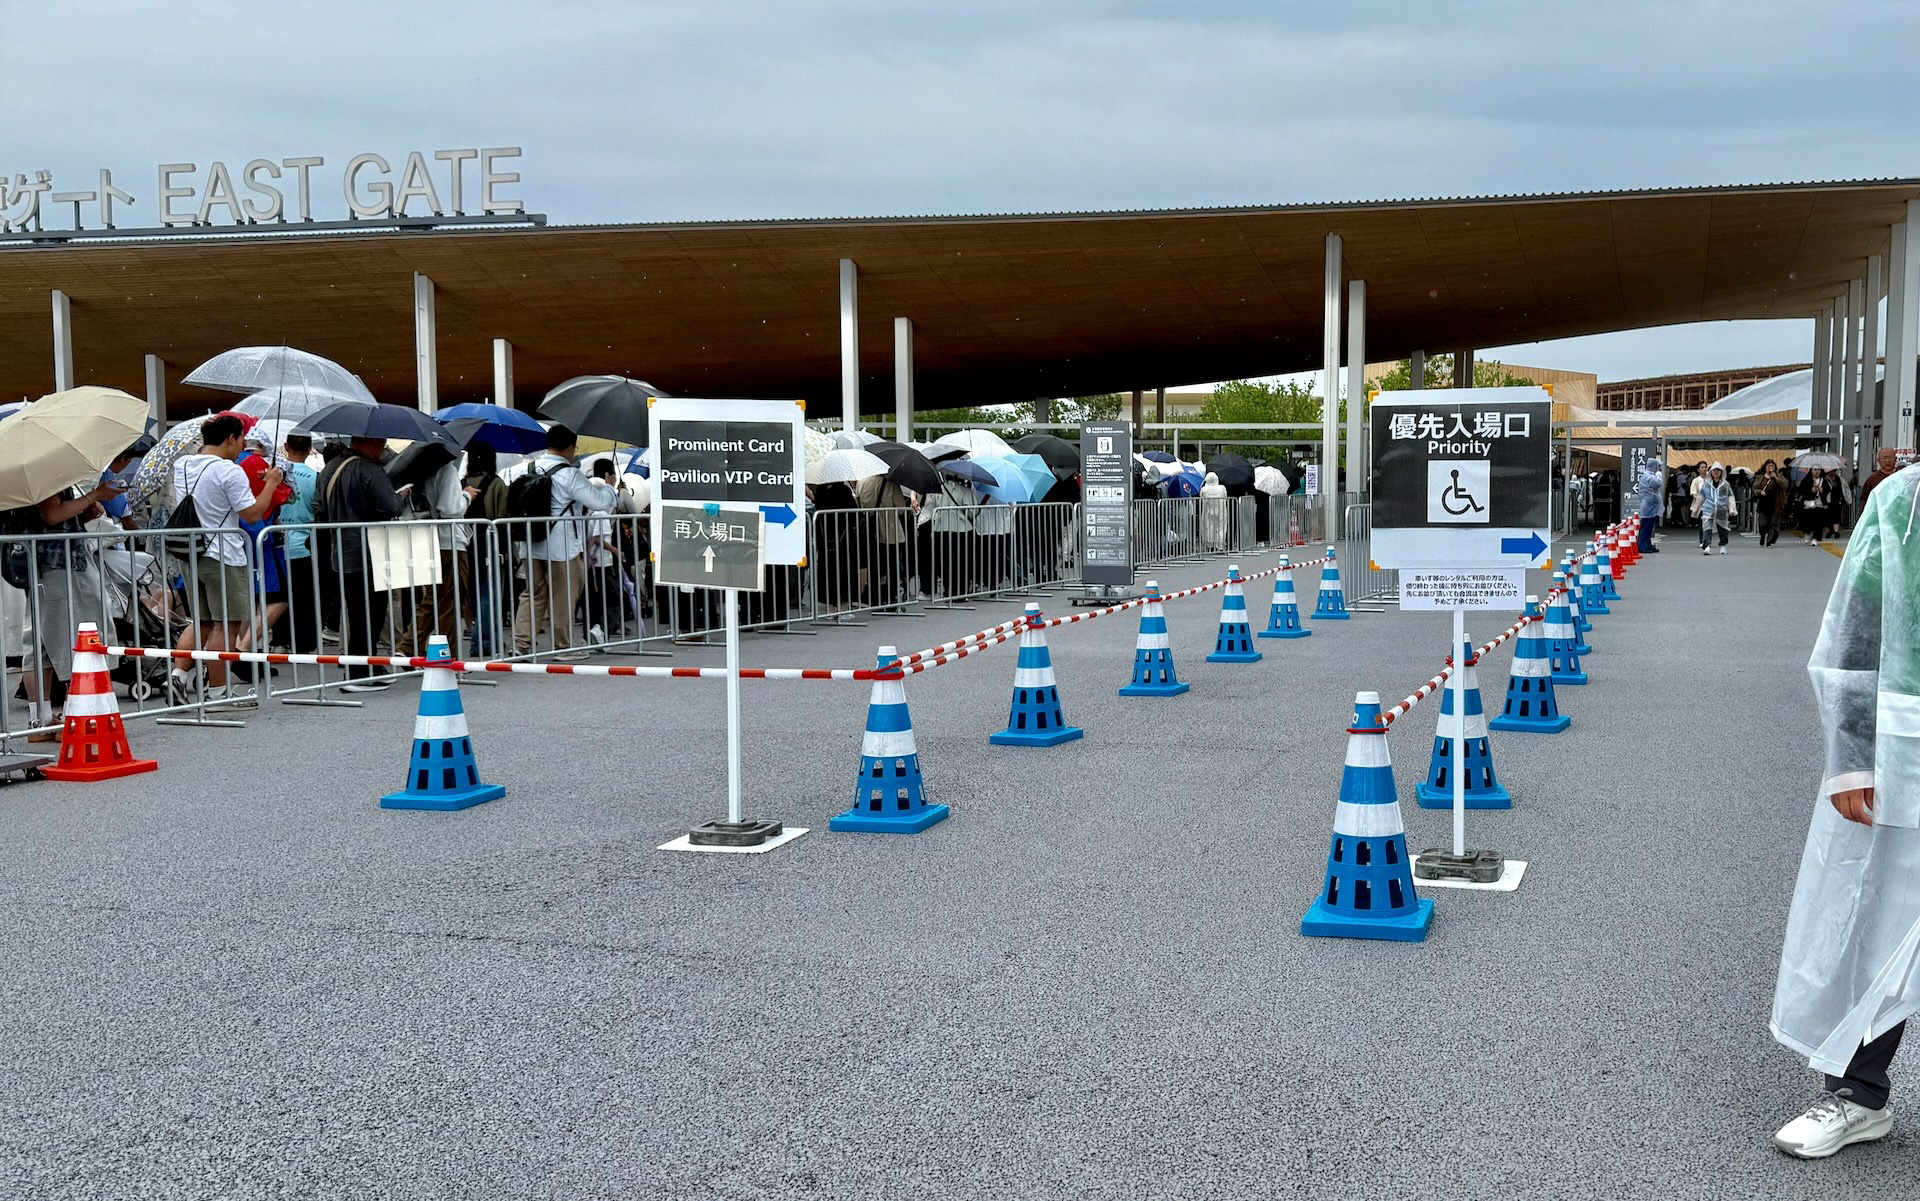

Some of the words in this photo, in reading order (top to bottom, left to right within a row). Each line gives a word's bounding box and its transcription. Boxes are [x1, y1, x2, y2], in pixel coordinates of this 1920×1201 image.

[0, 169, 135, 226] ゲート
[158, 157, 324, 224] EAST
[343, 147, 524, 216] GATE
[1388, 412, 1531, 440] 優先入場口
[668, 438, 744, 452] Prominent
[748, 439, 785, 453] Card
[1428, 440, 1491, 457] Priority
[661, 469, 720, 484] Pavilion
[724, 470, 753, 484] VIP
[757, 471, 793, 486] Card
[673, 519, 746, 543] 再入場口
